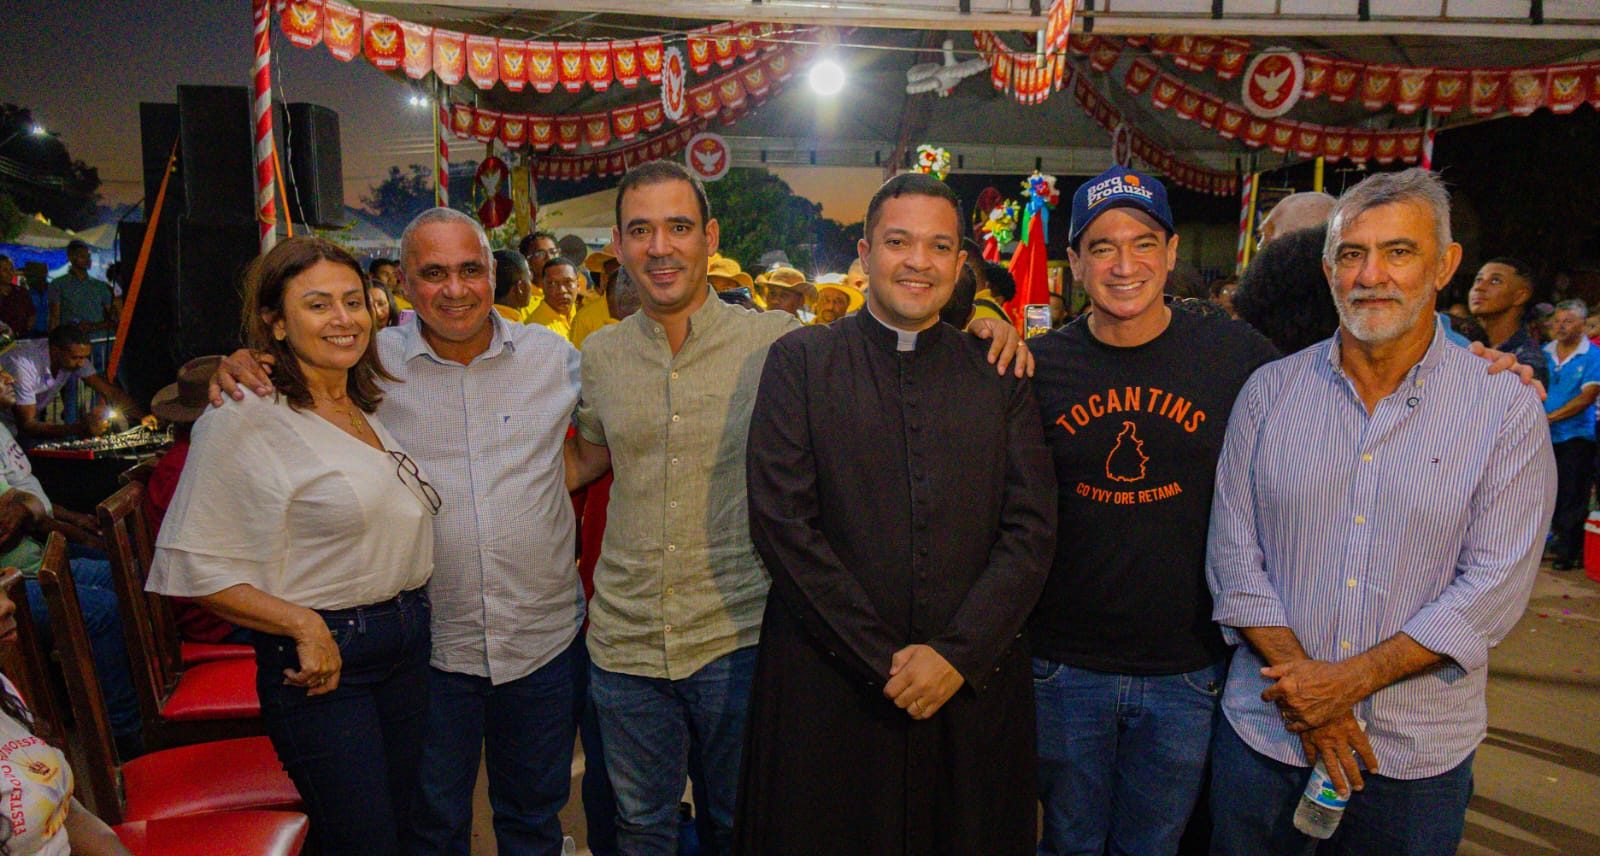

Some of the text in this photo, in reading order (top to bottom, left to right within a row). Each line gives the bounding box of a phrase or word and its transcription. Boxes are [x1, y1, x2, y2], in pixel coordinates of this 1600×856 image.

[1087, 183, 1153, 207] Produzir
[1056, 386, 1206, 435] TOCANTINS
[1076, 481, 1183, 504] CO YVY ORE RETAMA
